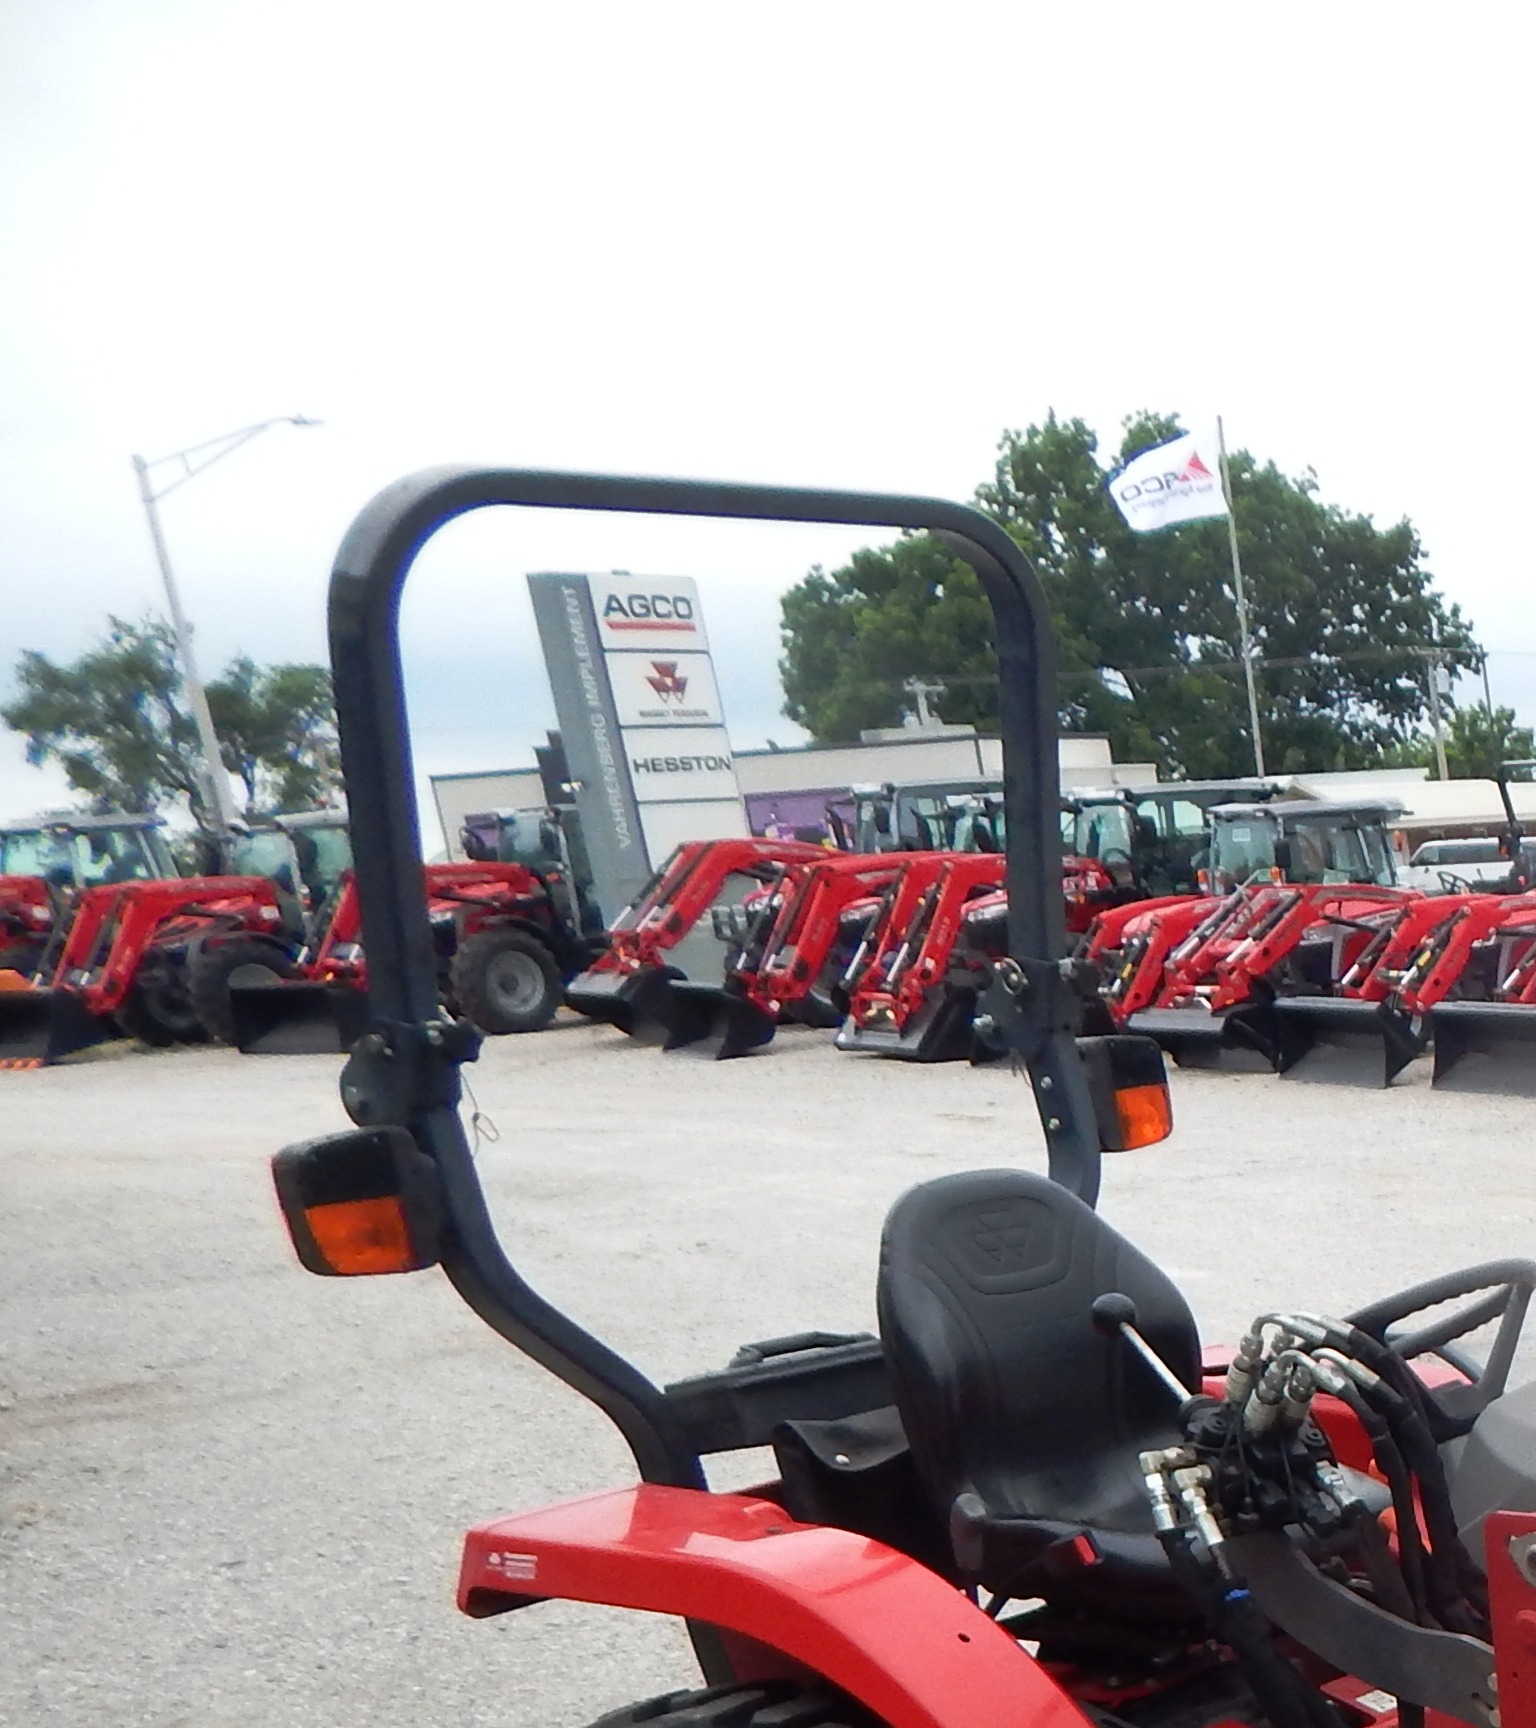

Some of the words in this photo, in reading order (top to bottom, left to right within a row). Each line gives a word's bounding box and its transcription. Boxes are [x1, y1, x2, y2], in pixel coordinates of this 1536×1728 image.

[603, 593, 694, 620] AGCO
[561, 585, 603, 706] IMPLEMENT
[633, 756, 732, 774] HESSTON
